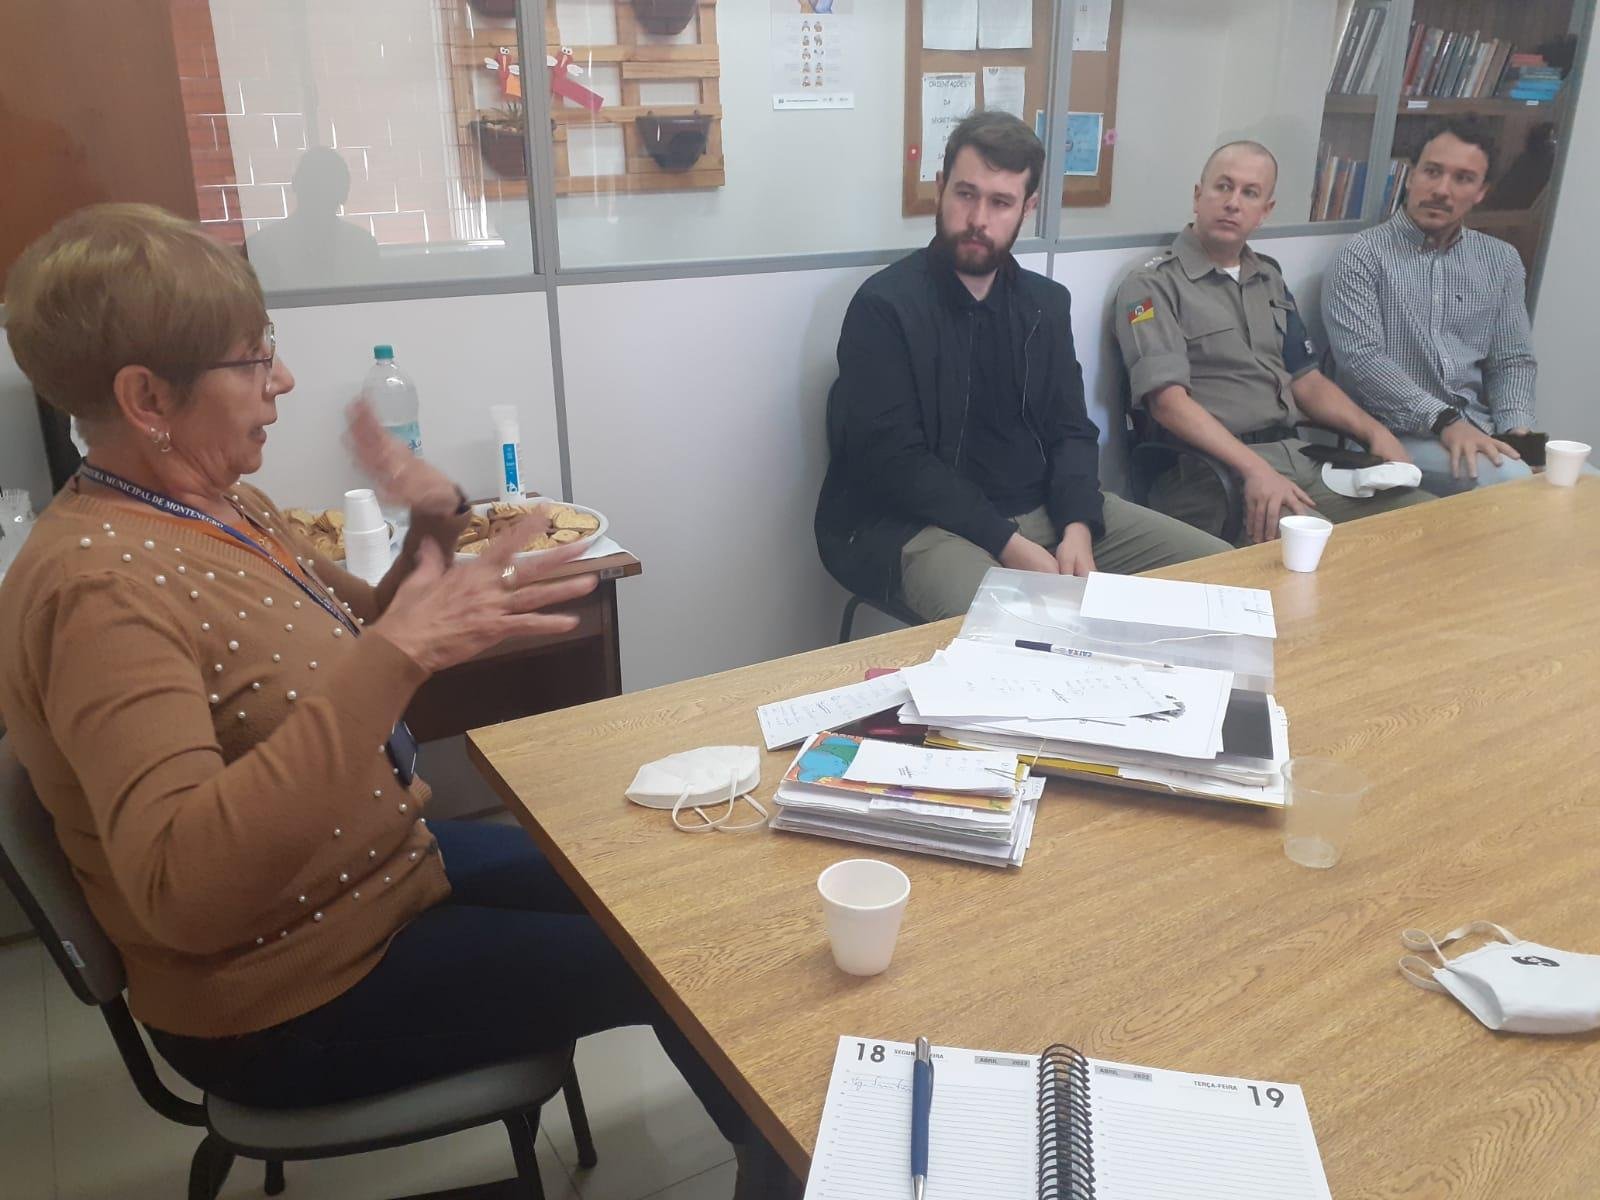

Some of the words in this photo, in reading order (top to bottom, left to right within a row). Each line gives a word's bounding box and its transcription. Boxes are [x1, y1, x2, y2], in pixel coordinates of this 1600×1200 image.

[106, 476, 151, 501] MUNICIPAL
[151, 495, 164, 506] DE
[164, 500, 224, 528] MONTENEGRO
[857, 1042, 886, 1063] 18
[979, 1057, 998, 1065] ABRIL
[1011, 1059, 1028, 1067] 2022
[1099, 1067, 1119, 1076] ABRIL
[1133, 1072, 1150, 1080] 2022
[1193, 1080, 1238, 1091] TERÇA-FEIRA
[1247, 1085, 1285, 1108] 19
